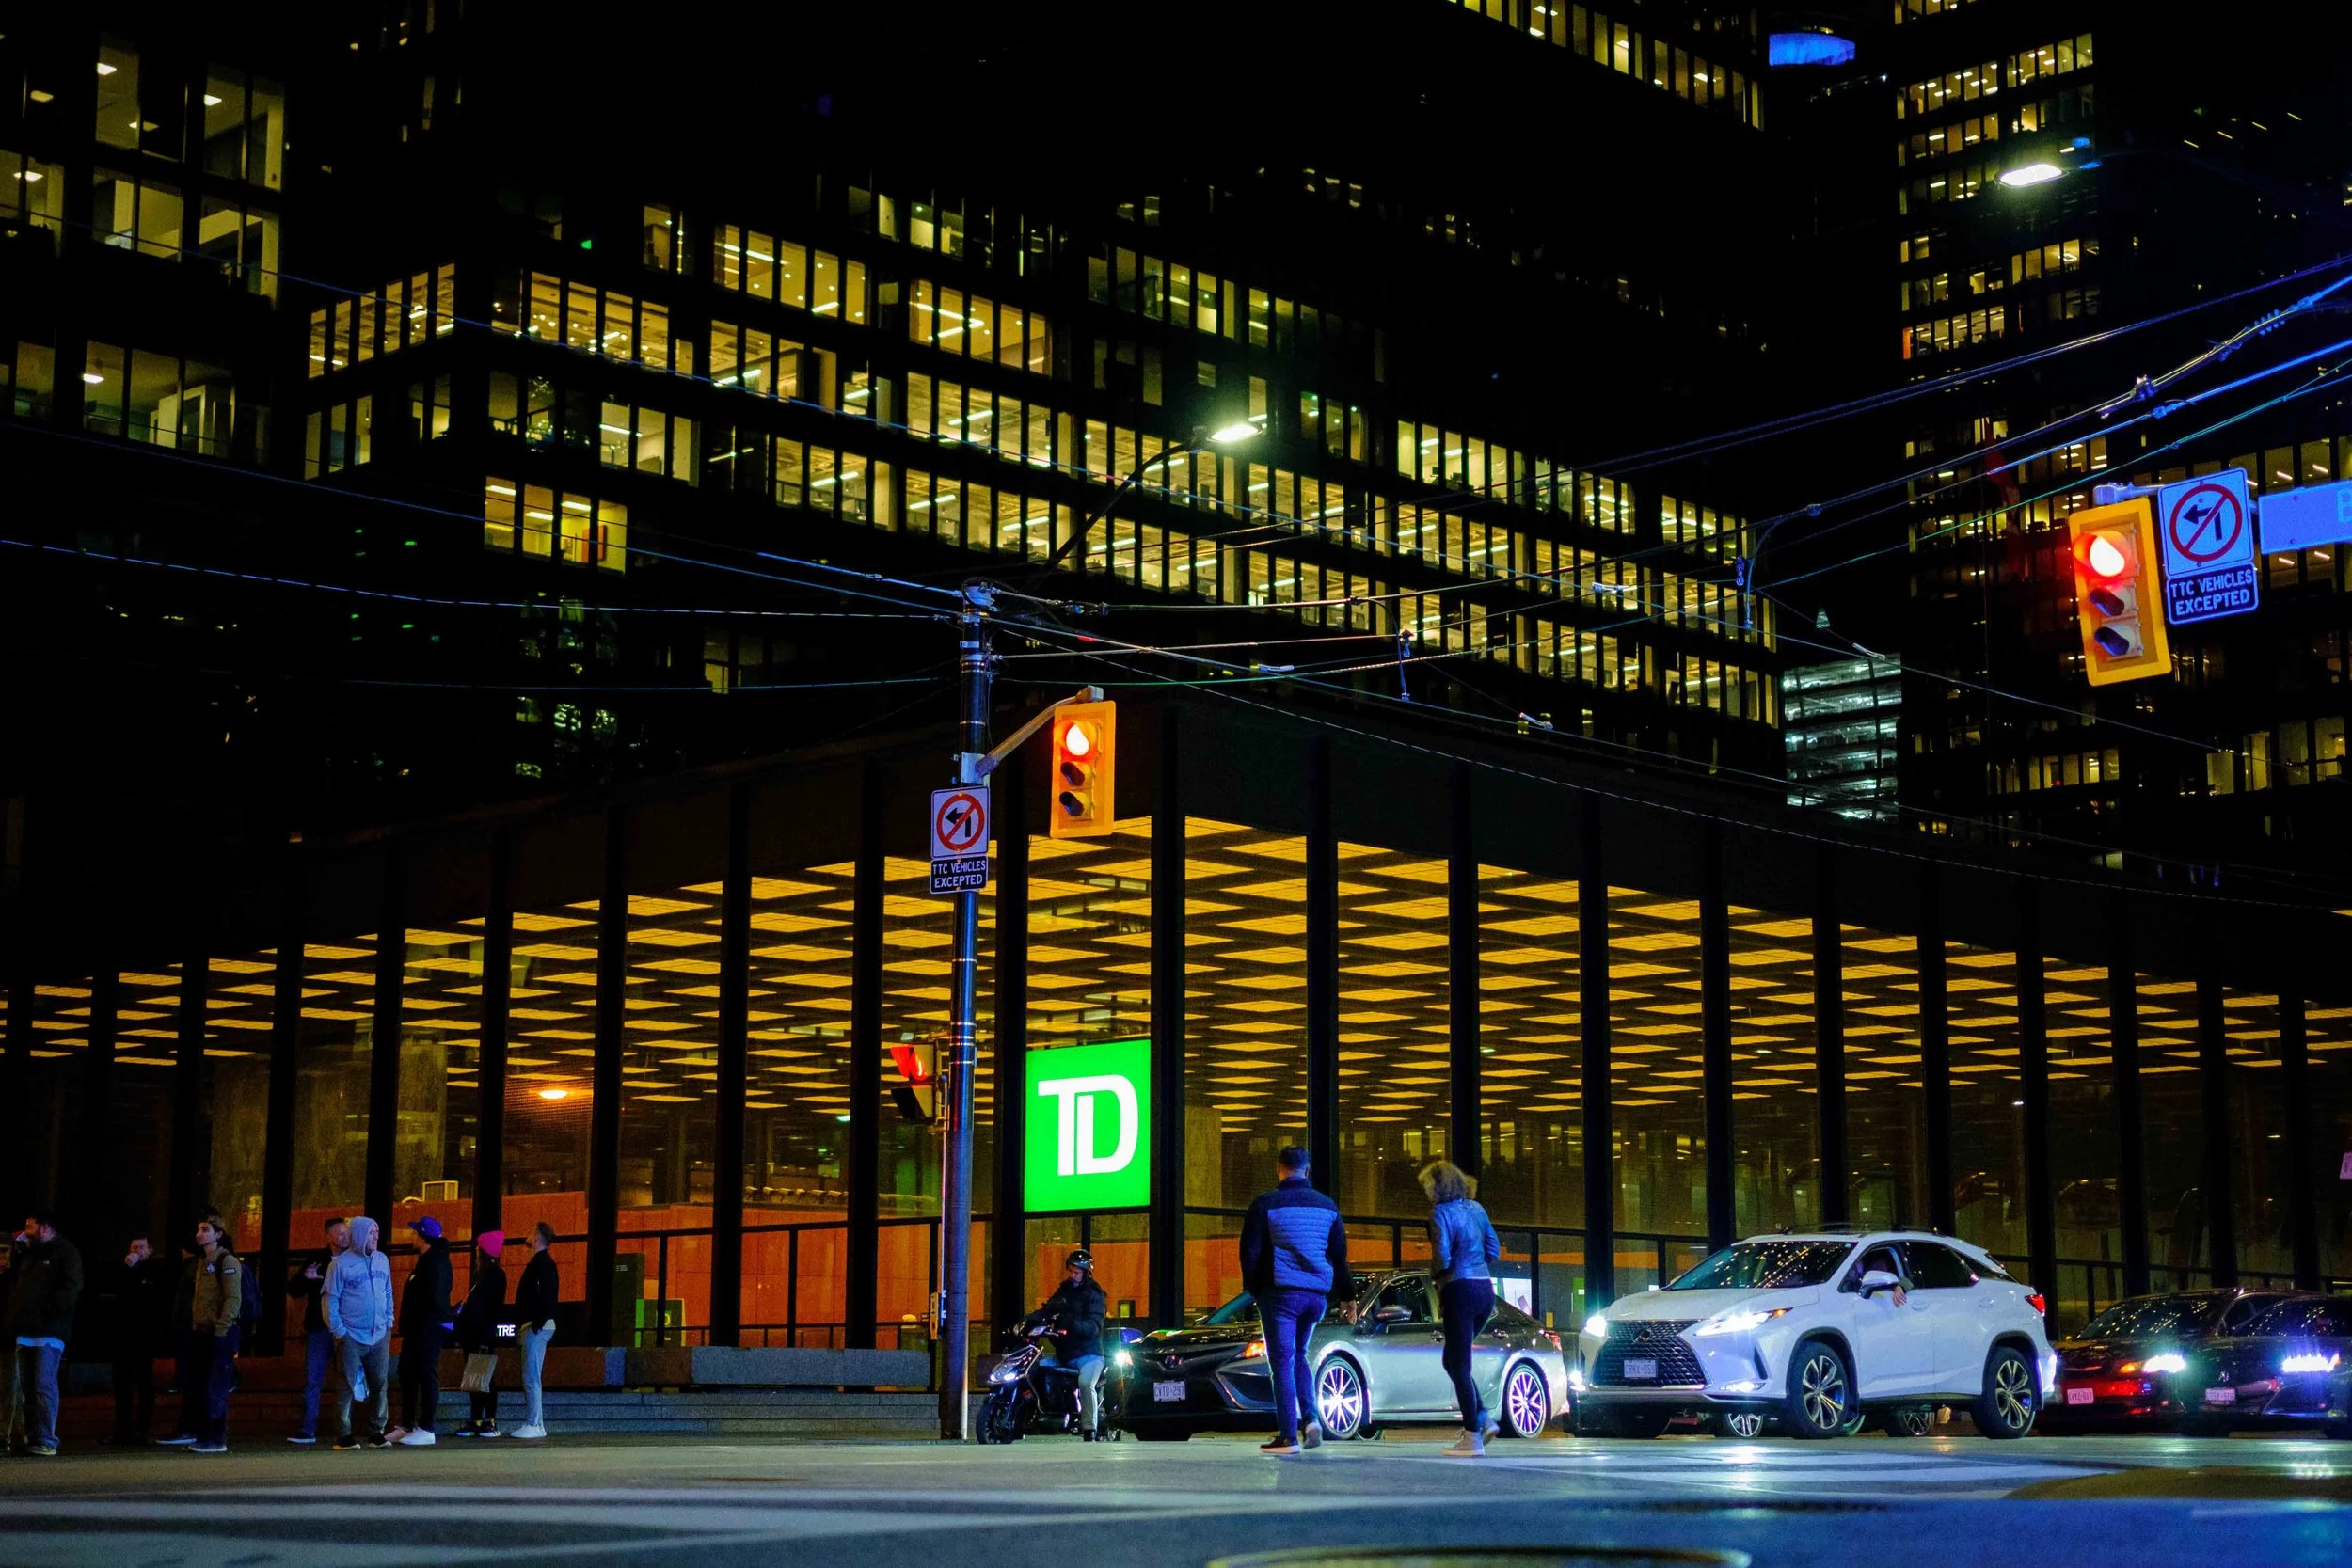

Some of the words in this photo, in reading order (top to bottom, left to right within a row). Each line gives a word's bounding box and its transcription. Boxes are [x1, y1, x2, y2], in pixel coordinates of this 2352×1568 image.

[2170, 580, 2194, 598] TTC
[2200, 568, 2253, 594] VEHICLES
[2175, 588, 2250, 616] EXCEPTED
[932, 863, 948, 875] TTC
[950, 860, 986, 874] VEHICLES
[934, 874, 983, 888] EXCEPTED
[1038, 1074, 1139, 1176] TD
[496, 1324, 516, 1337] TRE
